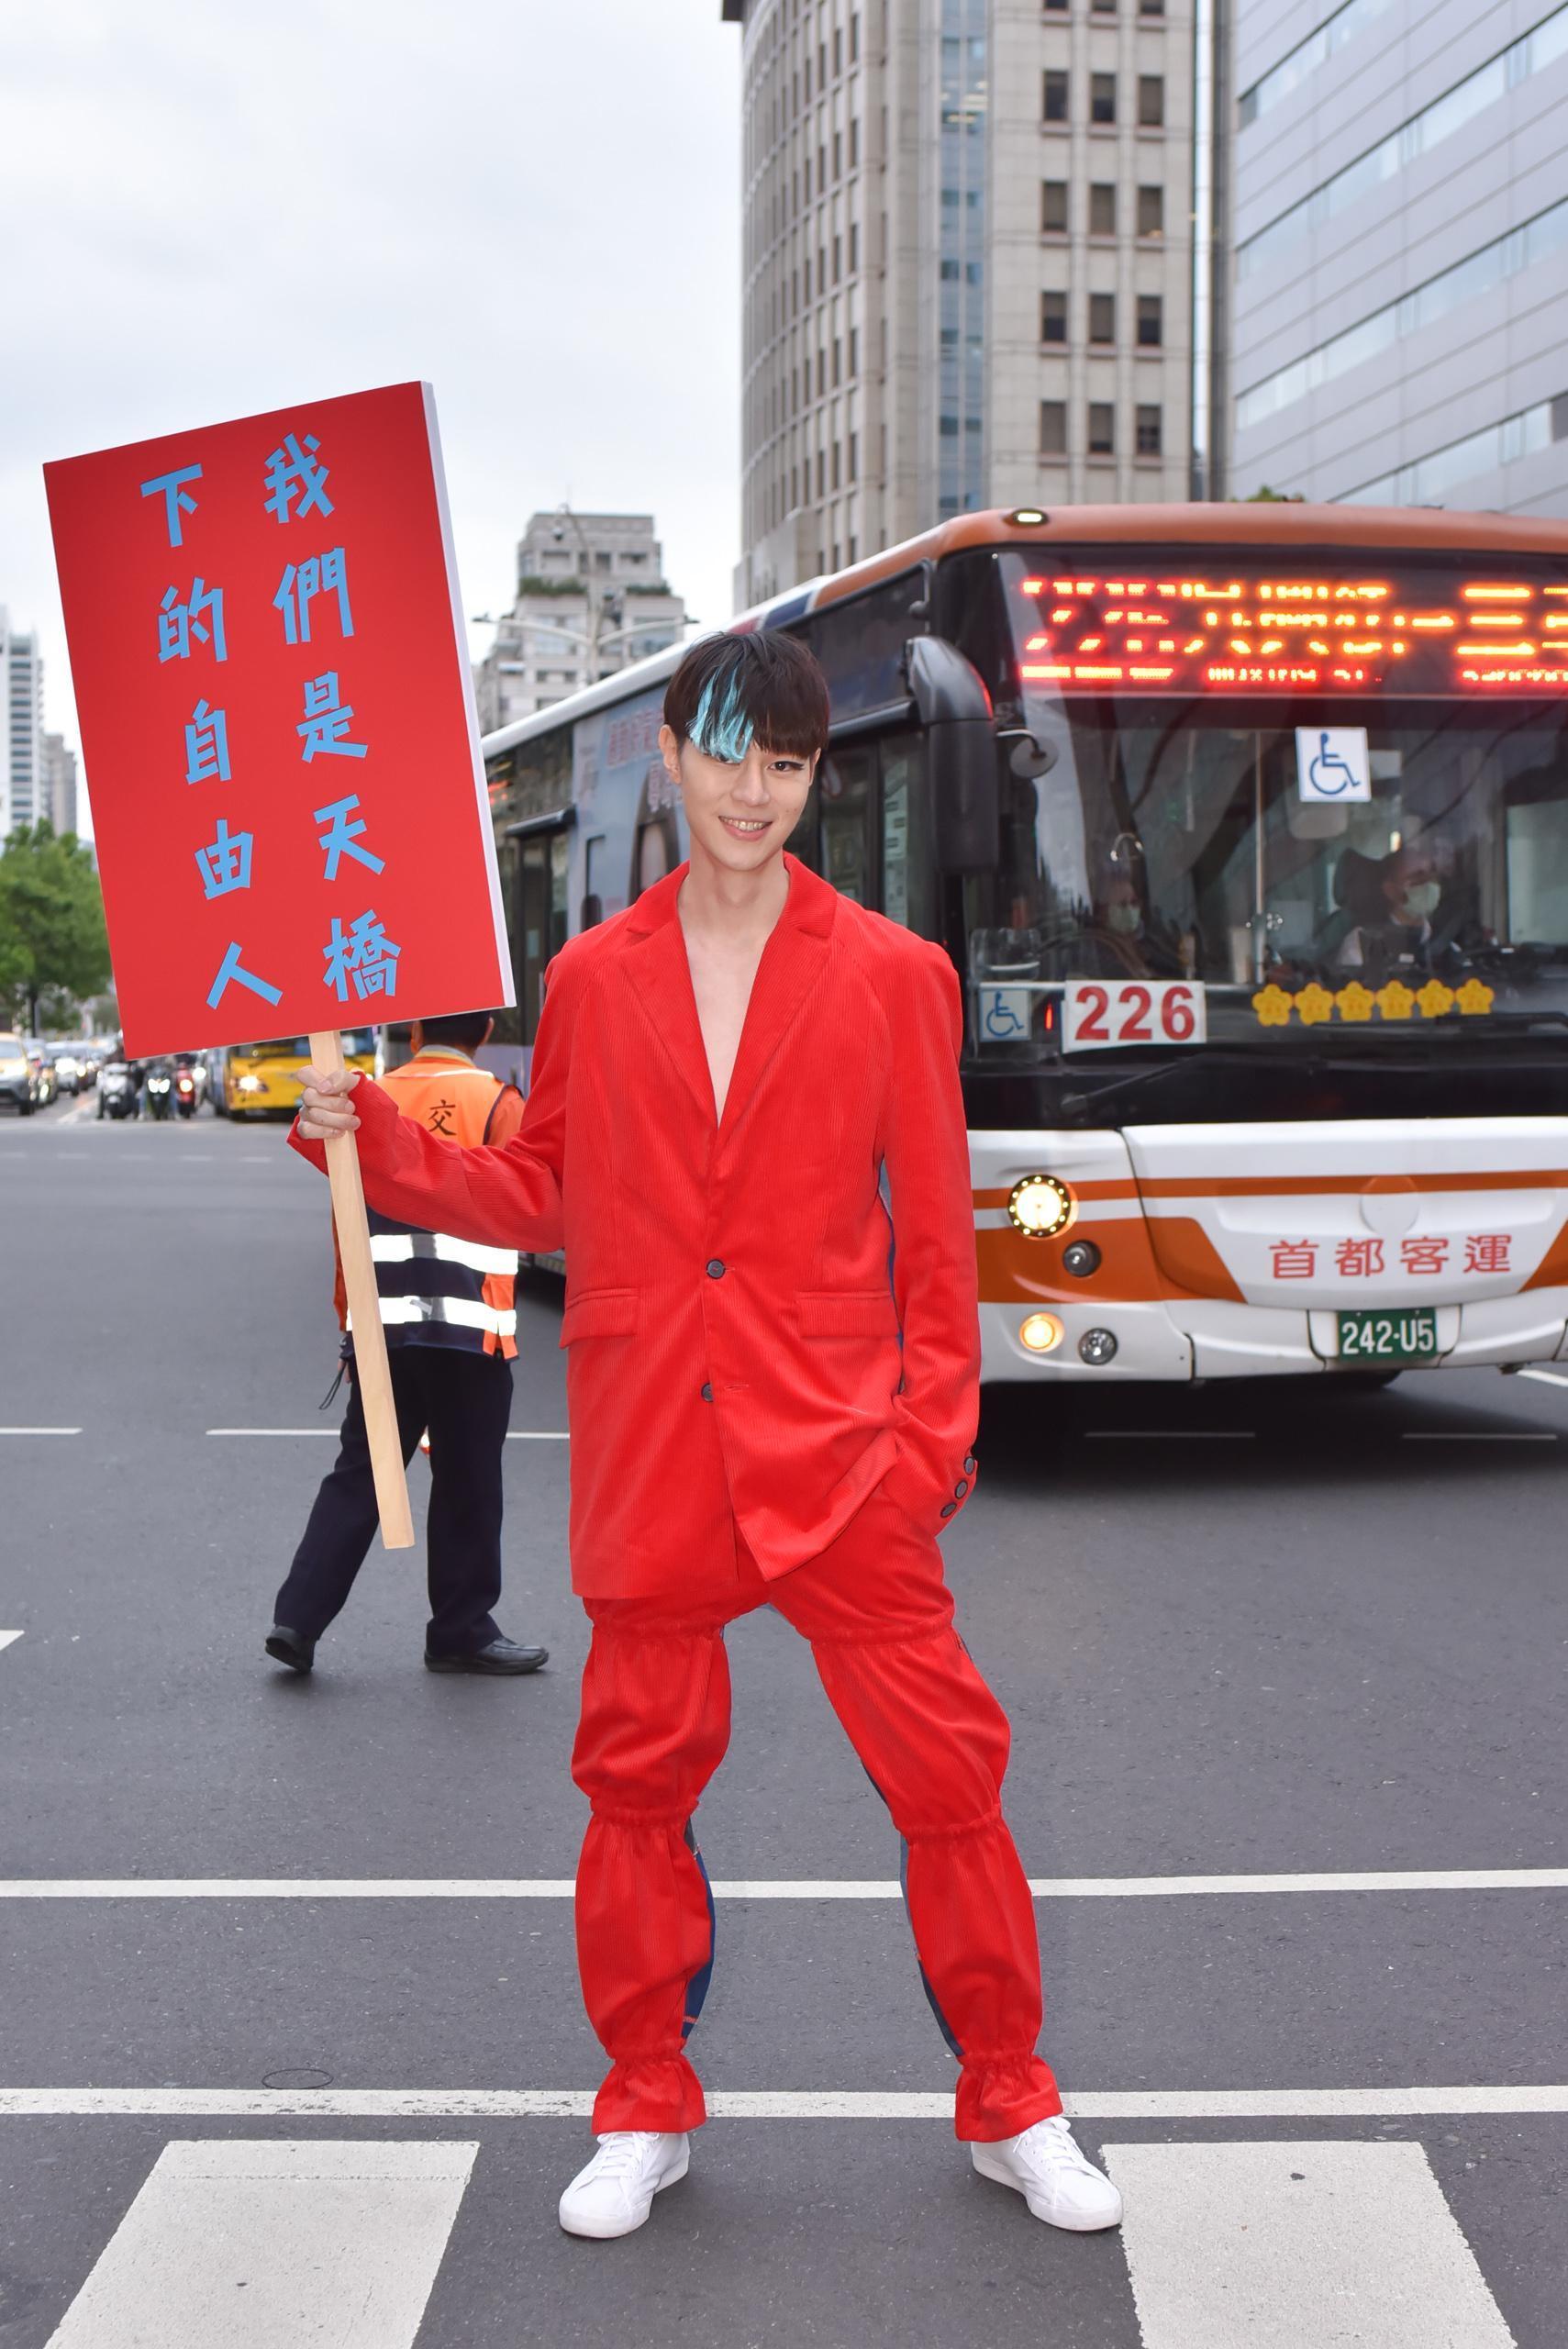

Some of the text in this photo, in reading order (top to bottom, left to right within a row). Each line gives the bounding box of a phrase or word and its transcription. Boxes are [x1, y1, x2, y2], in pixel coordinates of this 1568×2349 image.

[140, 463, 283, 1009] 下的自由人
[263, 433, 401, 1002] 我們是天橋
[1074, 985, 1195, 1041] 226
[428, 1098, 458, 1137] 交
[1268, 1233, 1512, 1280] 首都客運
